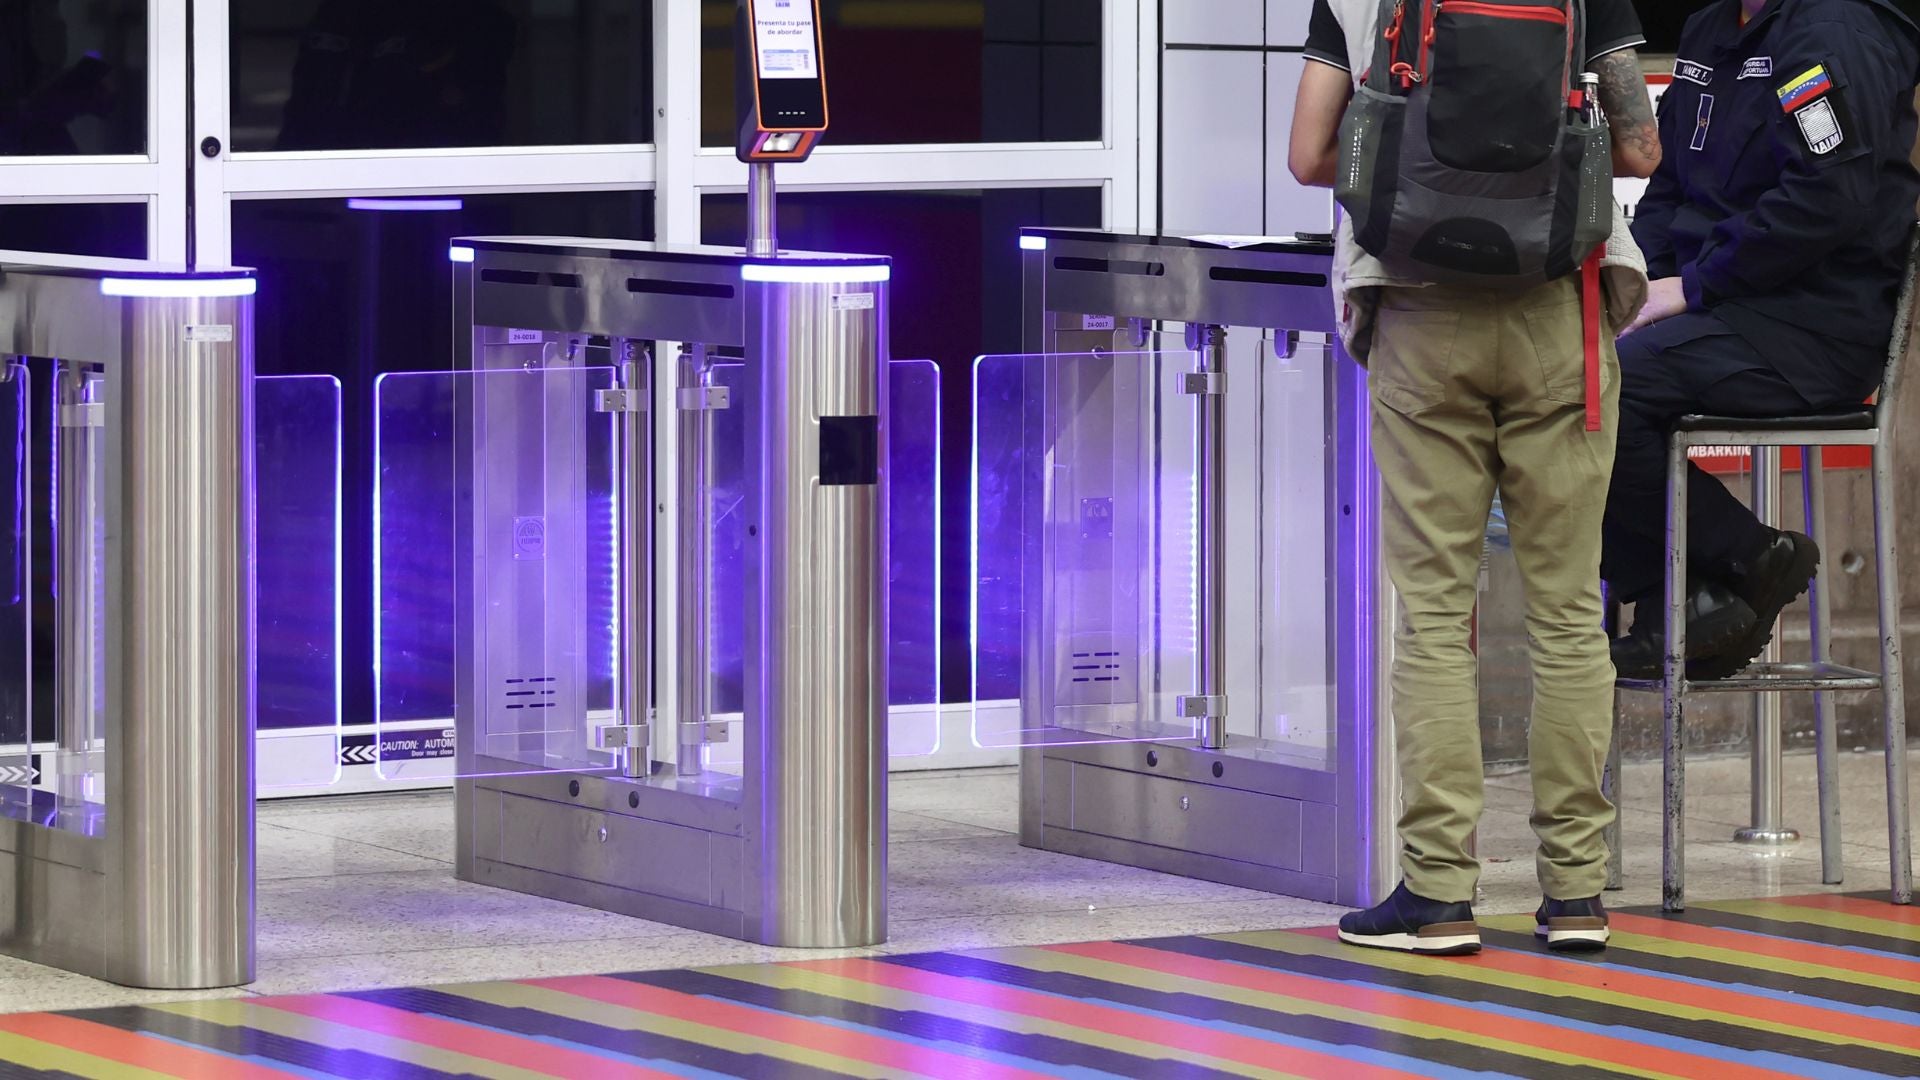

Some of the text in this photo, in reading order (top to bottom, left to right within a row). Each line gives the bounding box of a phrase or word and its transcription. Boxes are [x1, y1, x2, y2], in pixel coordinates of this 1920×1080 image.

[1813, 131, 1841, 153] IAIM
[380, 740, 419, 752] CAUTION:
[426, 750, 438, 758] may
